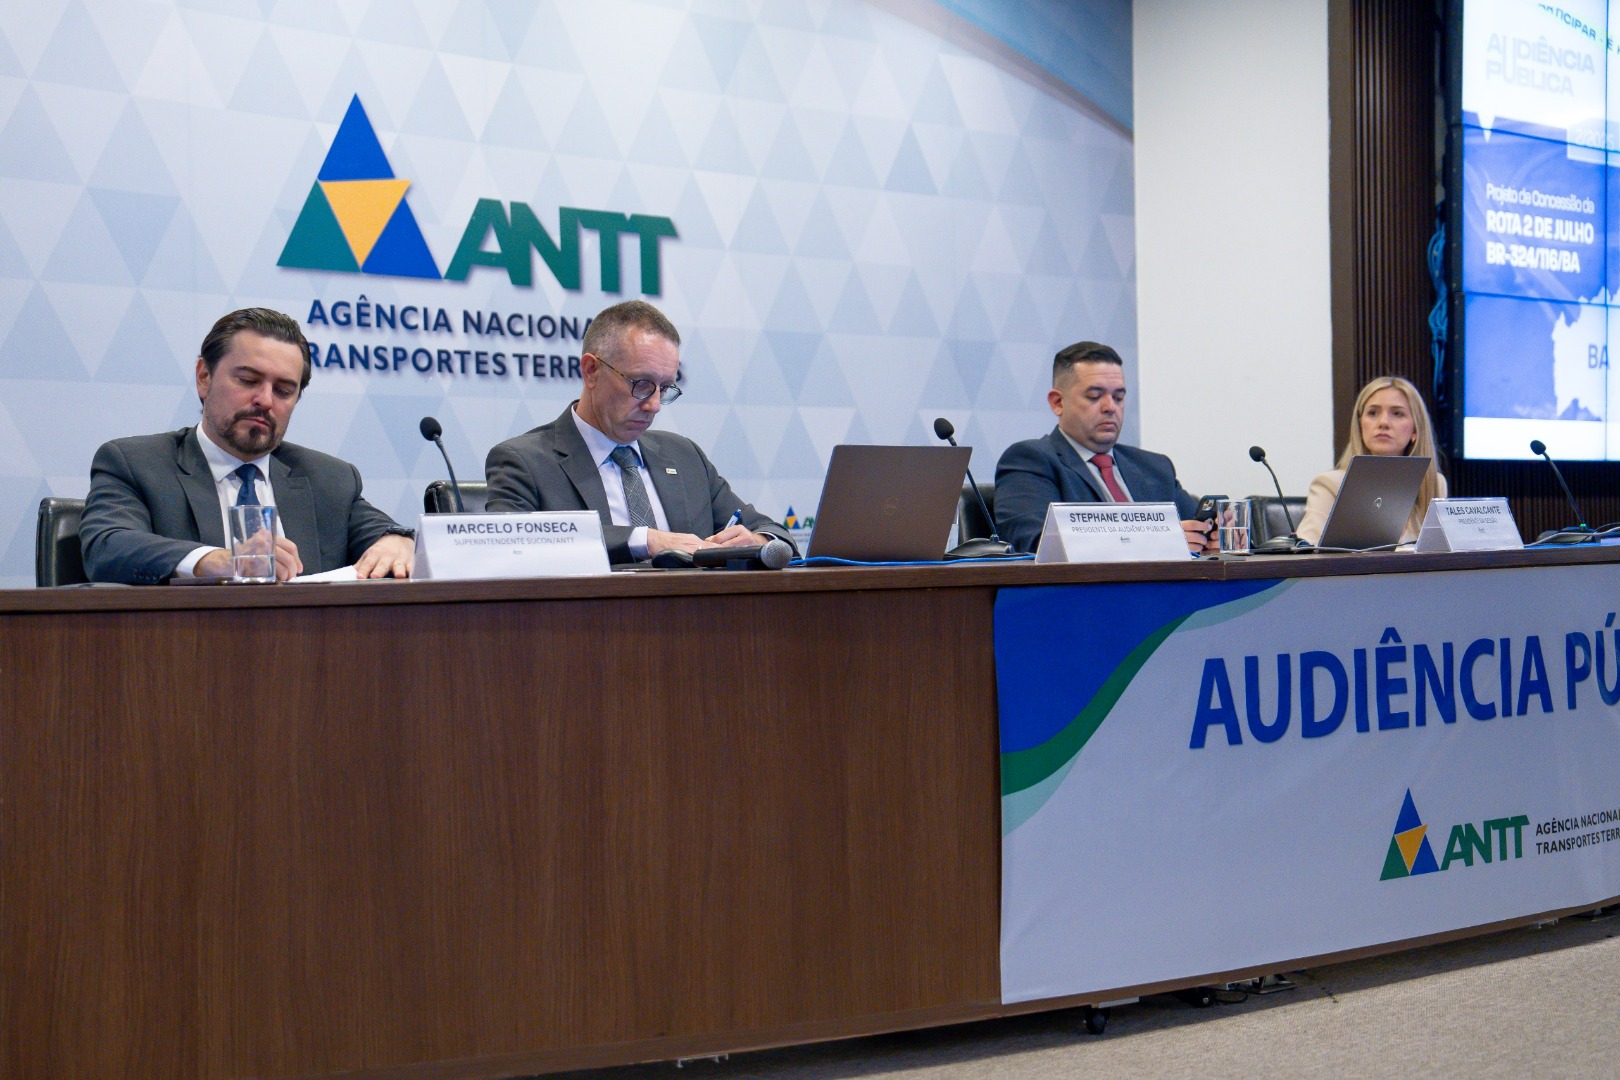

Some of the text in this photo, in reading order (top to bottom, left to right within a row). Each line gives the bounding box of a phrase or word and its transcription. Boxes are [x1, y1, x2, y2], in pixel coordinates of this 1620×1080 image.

[1487, 32, 1596, 76] AUDIÊNCIA
[1486, 182, 1595, 215] Projeto de Concessão da
[1486, 209, 1595, 246] ROTA 2 DE JULHO
[443, 197, 679, 297] ANTT
[1486, 241, 1580, 274] BR-324/116/BA
[306, 294, 593, 340] AGÊNCIA NACION
[308, 341, 507, 376] RANSPORTES
[1588, 344, 1611, 370] BA
[1070, 512, 1165, 523] STEPHANE QUEBAUD
[1446, 505, 1501, 515] TALES CAVALCANTE
[447, 522, 578, 534] MARCELO FONSECA
[454, 537, 526, 546] SUPERINTENDENTE
[1189, 626, 1554, 749] AUDIÊNCIA
[1439, 814, 1530, 871] ANTT
[1535, 817, 1580, 837] AGÊNCIA
[1535, 831, 1600, 856] TRANSPORTES
